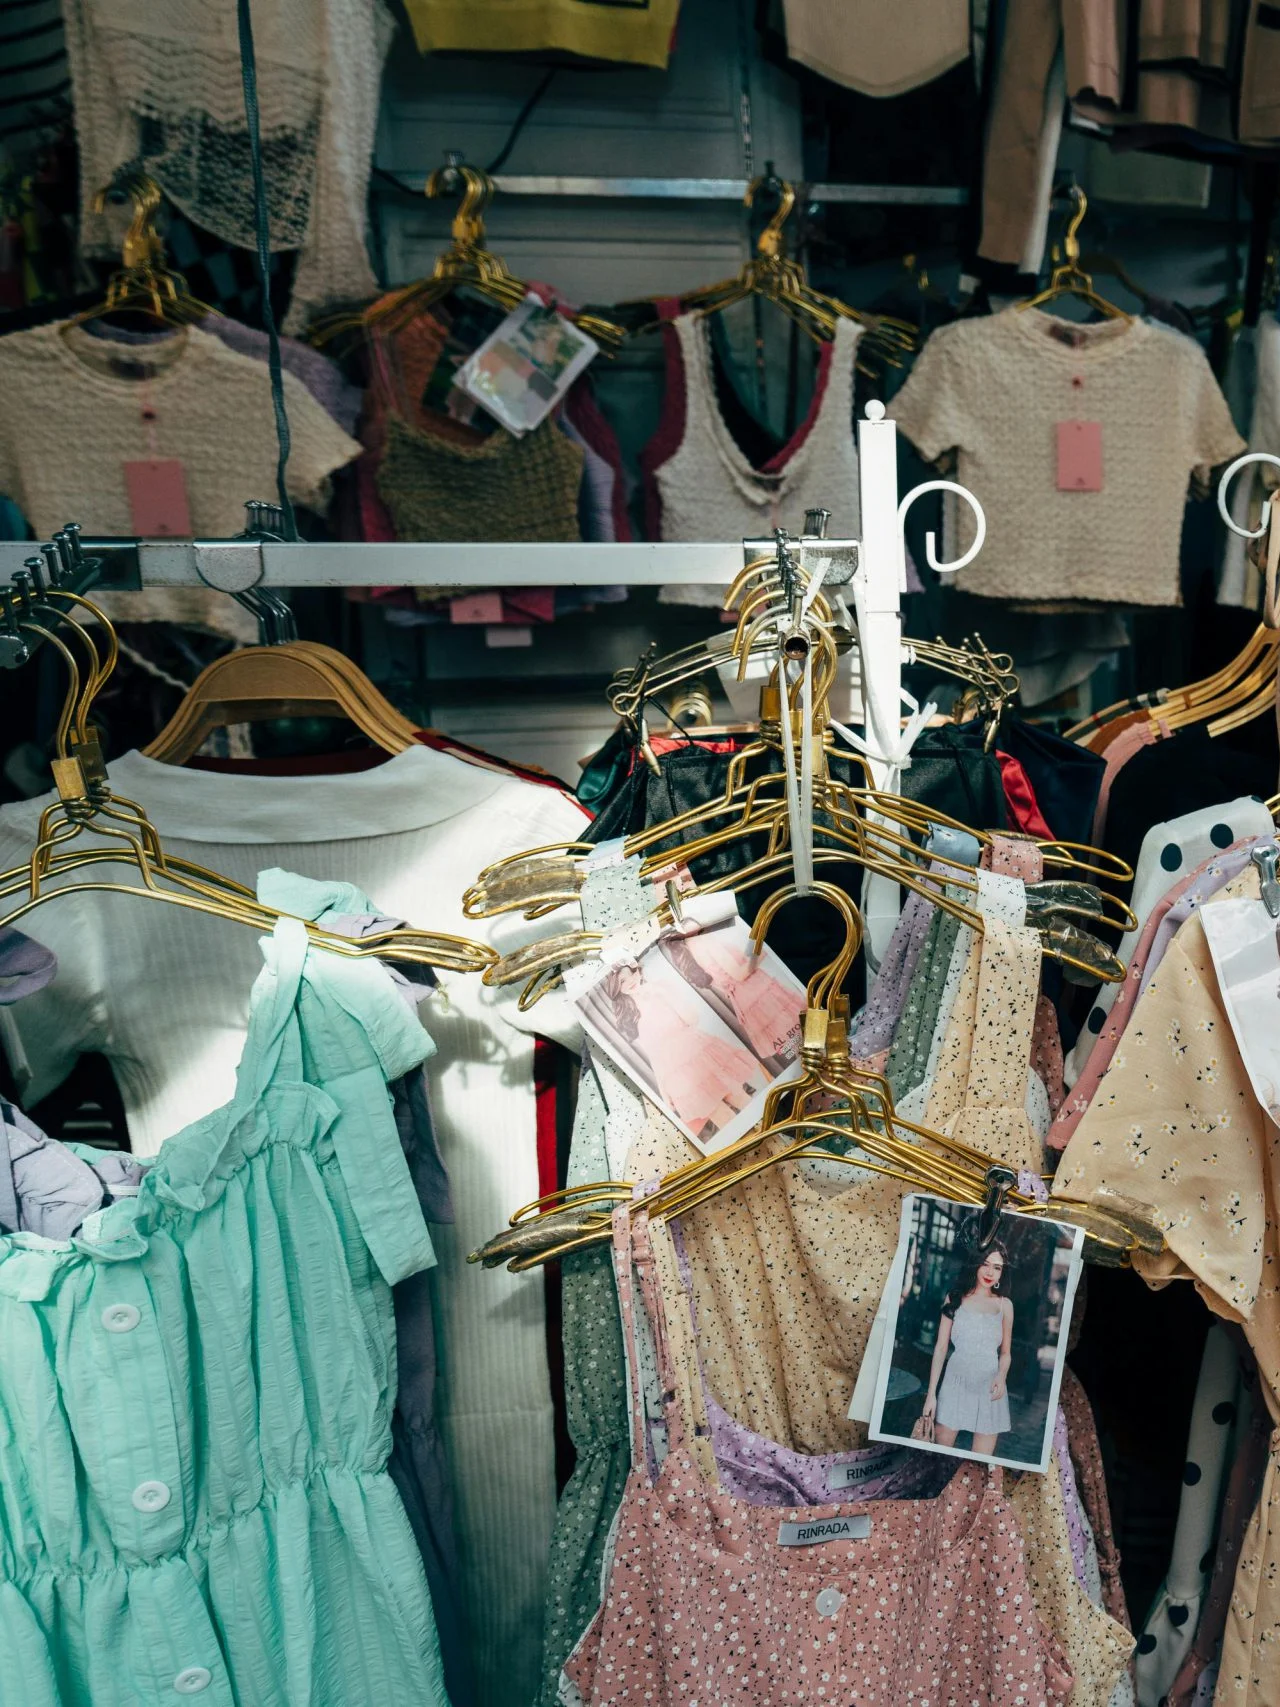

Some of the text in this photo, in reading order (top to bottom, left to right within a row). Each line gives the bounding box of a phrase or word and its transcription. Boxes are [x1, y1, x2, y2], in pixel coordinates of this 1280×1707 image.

[772, 1037, 786, 1050] AL
[786, 1023, 801, 1038] gro
[797, 1522, 850, 1540] RINRADA
